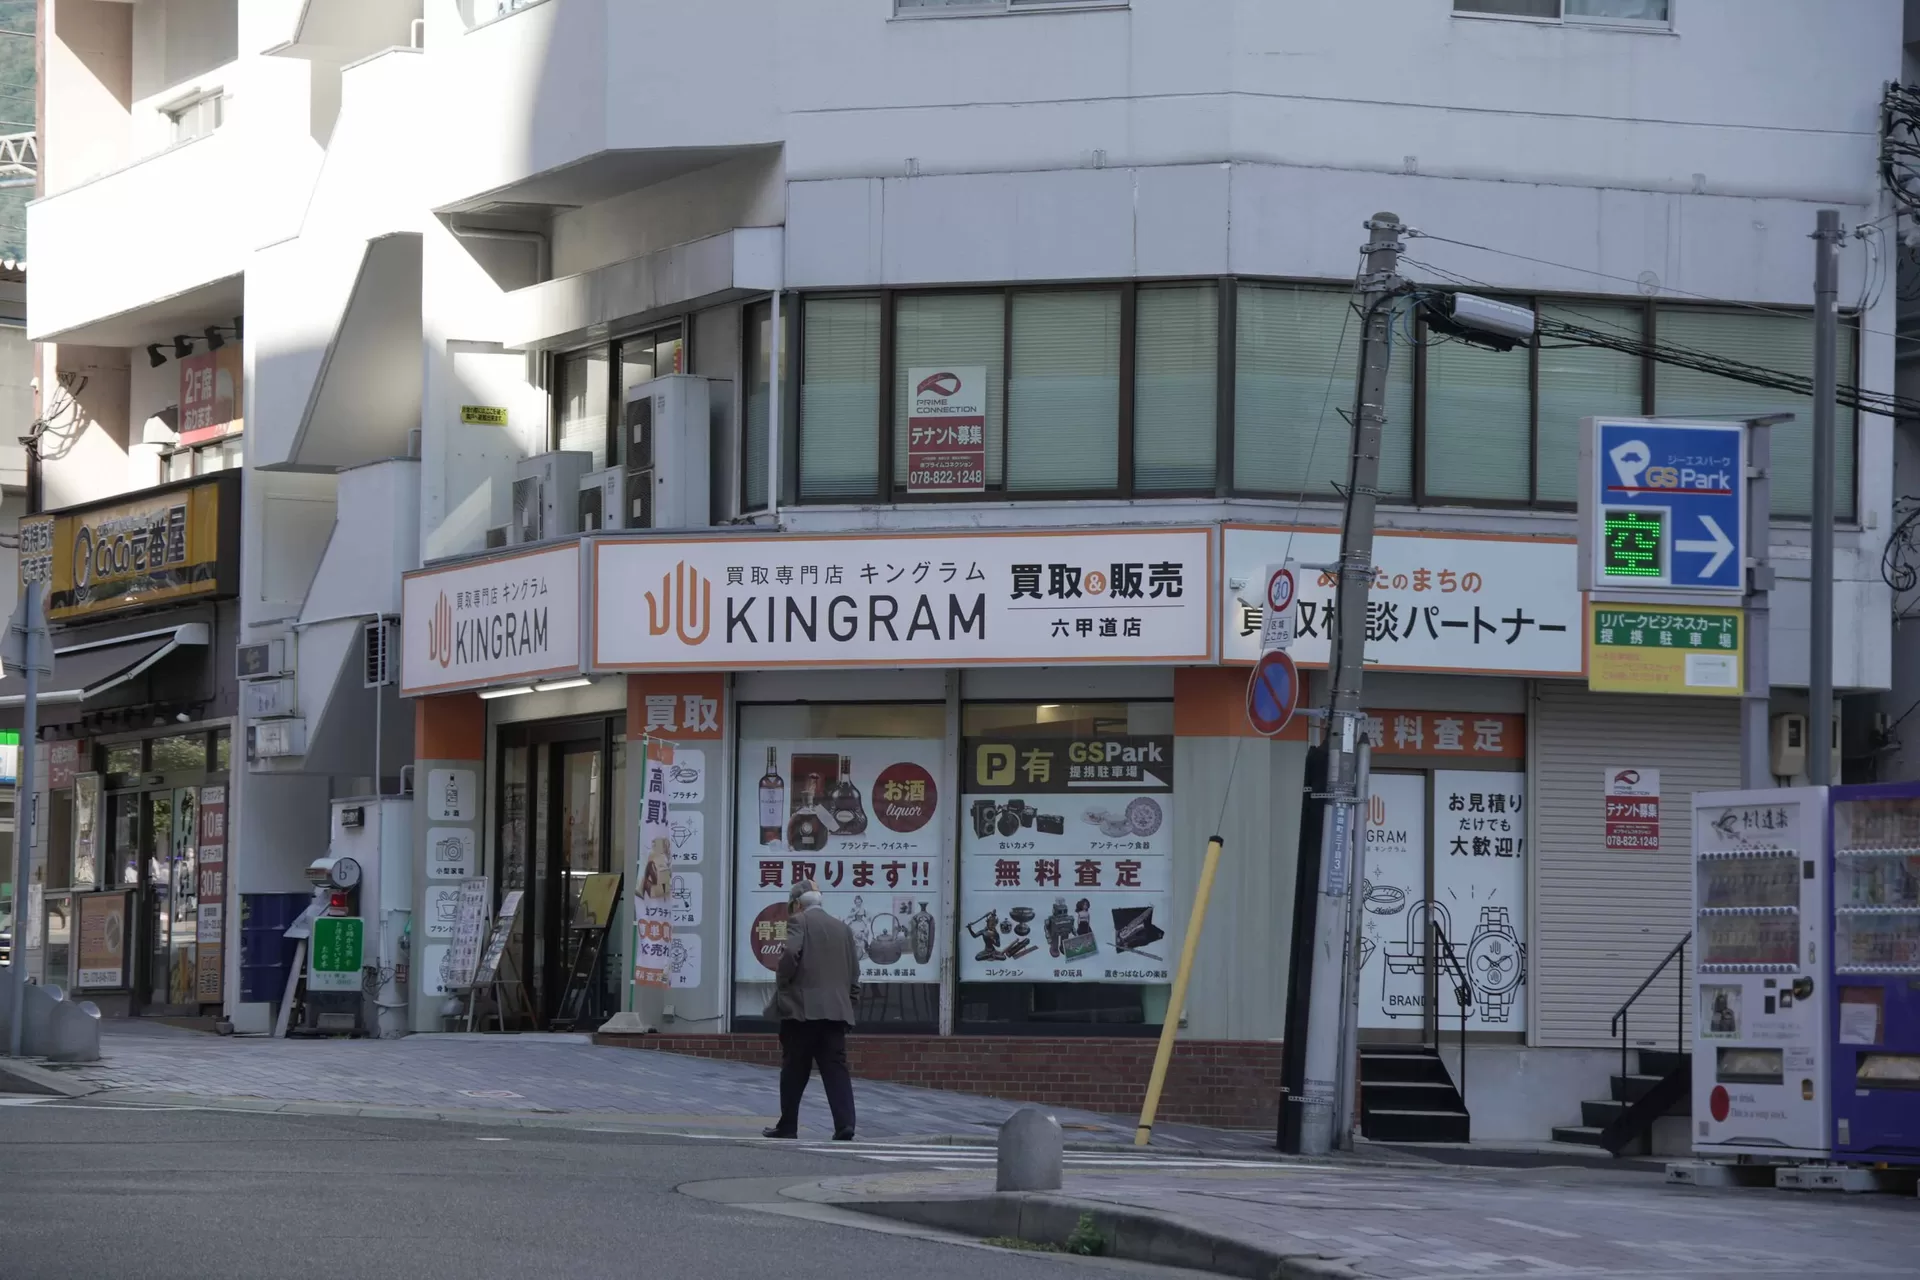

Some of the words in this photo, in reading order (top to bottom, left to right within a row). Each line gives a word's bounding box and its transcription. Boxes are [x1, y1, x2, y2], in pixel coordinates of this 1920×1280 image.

[185, 367, 213, 404] 2F席
[917, 406, 977, 414] CONNECTION
[911, 425, 982, 445] テナント募集
[1667, 454, 1731, 466] ジーエスパーク
[910, 470, 982, 484] 078-822-1248
[1605, 513, 1660, 577] 空
[726, 563, 844, 586] 買取専門店
[860, 560, 986, 584] キングラム
[456, 587, 499, 611] 買取専門店
[502, 576, 548, 603] キングラム
[1273, 581, 1289, 600] 30
[726, 593, 986, 644] KINGRAM
[1051, 617, 1142, 638] 六甲道店
[1601, 613, 1732, 632] リパークビジネスカード
[456, 606, 548, 665] KINGRAM
[1600, 628, 1732, 648] 提携駐車場
[644, 694, 719, 733] 買取
[1360, 715, 1504, 752] 無料査定
[1021, 747, 1054, 783] 有
[1069, 765, 1138, 778] 提携駐車場
[668, 791, 698, 800] ・プラチナ
[883, 780, 925, 802] お酒
[885, 803, 922, 820] liquor
[1449, 792, 1522, 813] お見積り
[1607, 803, 1658, 818] テナント募集
[443, 809, 460, 818] お酒
[203, 811, 223, 838] 10席
[1459, 817, 1511, 832] だけでも
[840, 842, 918, 850] ブランデー、ウイスキー
[998, 842, 1035, 850] 古いカメラ
[1090, 841, 1150, 850] アンティーク食器
[1366, 829, 1407, 844] GRAM
[1607, 836, 1658, 847] 078-822-1248
[1450, 835, 1523, 858] 大歓迎!
[435, 866, 465, 875] 小型家電
[758, 860, 930, 889] 買取ります!!
[994, 858, 1142, 887] 無料査定
[200, 869, 223, 897] 30席
[430, 924, 454, 934] ブランド
[755, 920, 788, 941] 骨董
[760, 942, 786, 954] anti
[985, 969, 1024, 977] コレクション
[1053, 969, 1083, 977] 昔の玩具
[1104, 969, 1168, 979] 置きっぱなしの楽器
